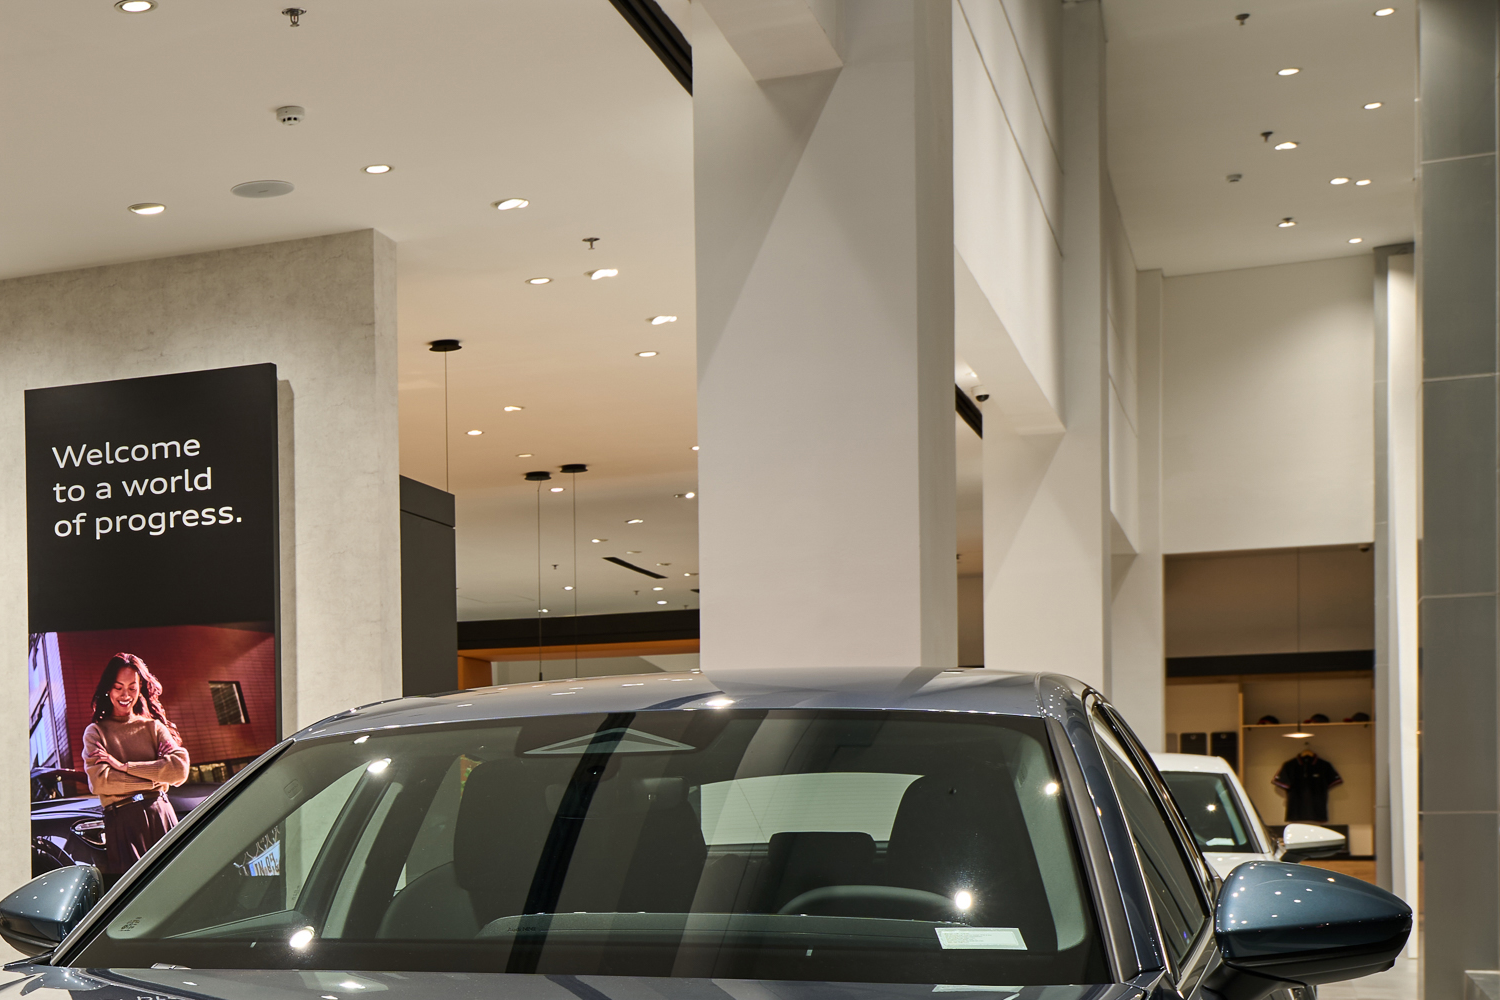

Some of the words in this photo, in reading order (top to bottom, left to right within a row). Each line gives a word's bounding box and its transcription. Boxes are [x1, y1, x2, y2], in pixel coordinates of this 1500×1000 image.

[51, 437, 201, 469] Welcome
[52, 482, 85, 503] to
[95, 481, 112, 500] a
[121, 466, 212, 497] world
[54, 512, 87, 538] of
[95, 505, 242, 540] progress.
